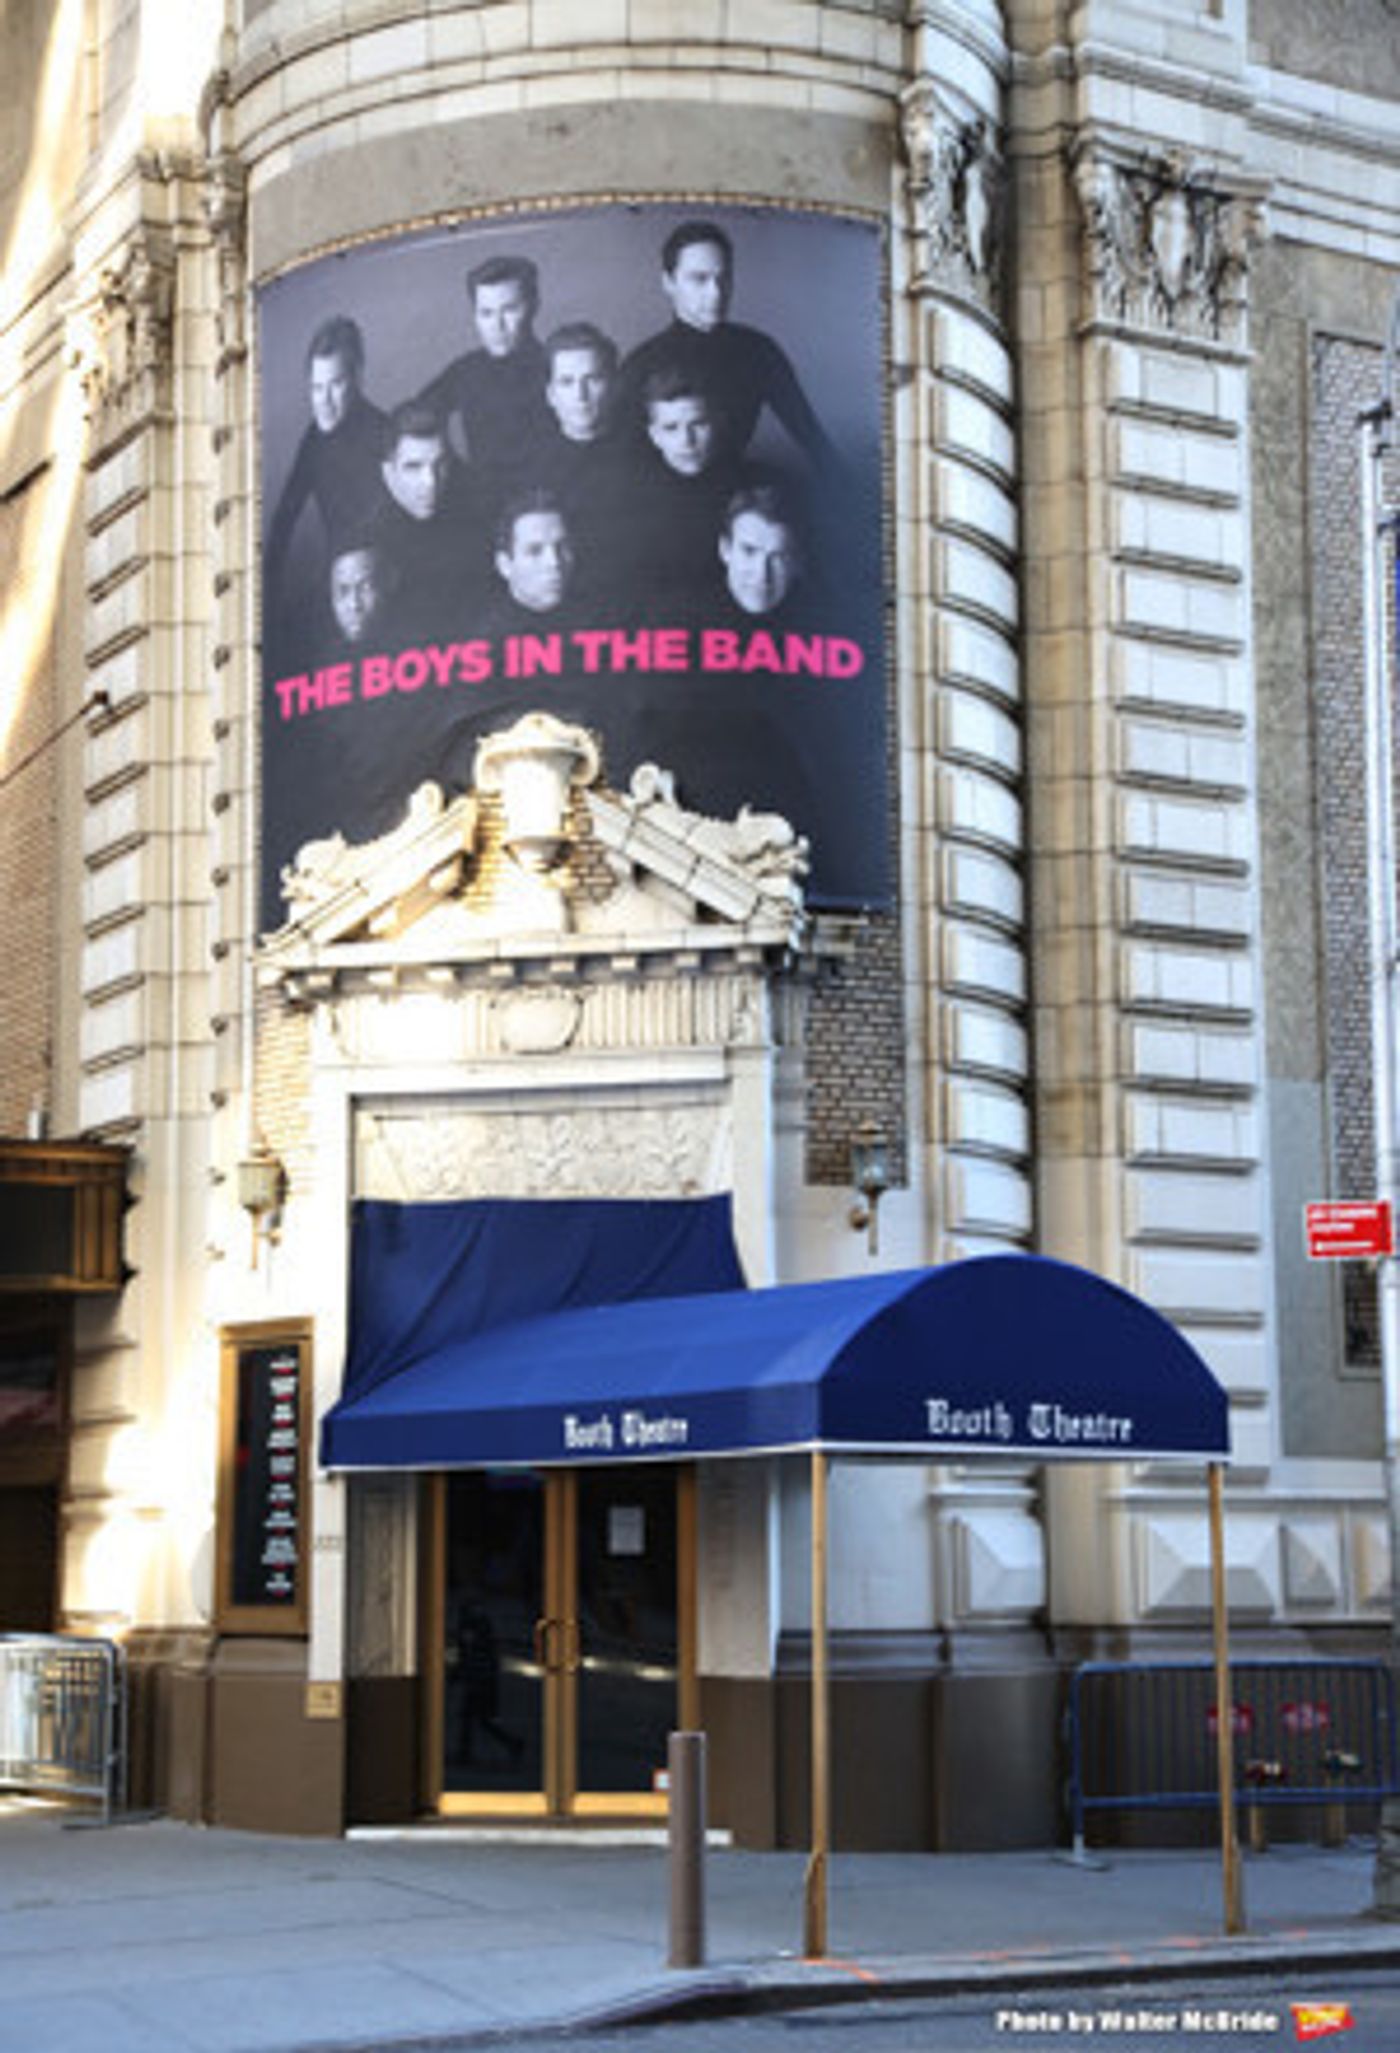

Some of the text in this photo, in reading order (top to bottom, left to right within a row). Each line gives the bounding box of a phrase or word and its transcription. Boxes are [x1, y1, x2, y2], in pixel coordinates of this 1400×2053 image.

[274, 628, 865, 721] THE BOYS IN THE BAND
[926, 1398, 1133, 1442] Booth Theatre
